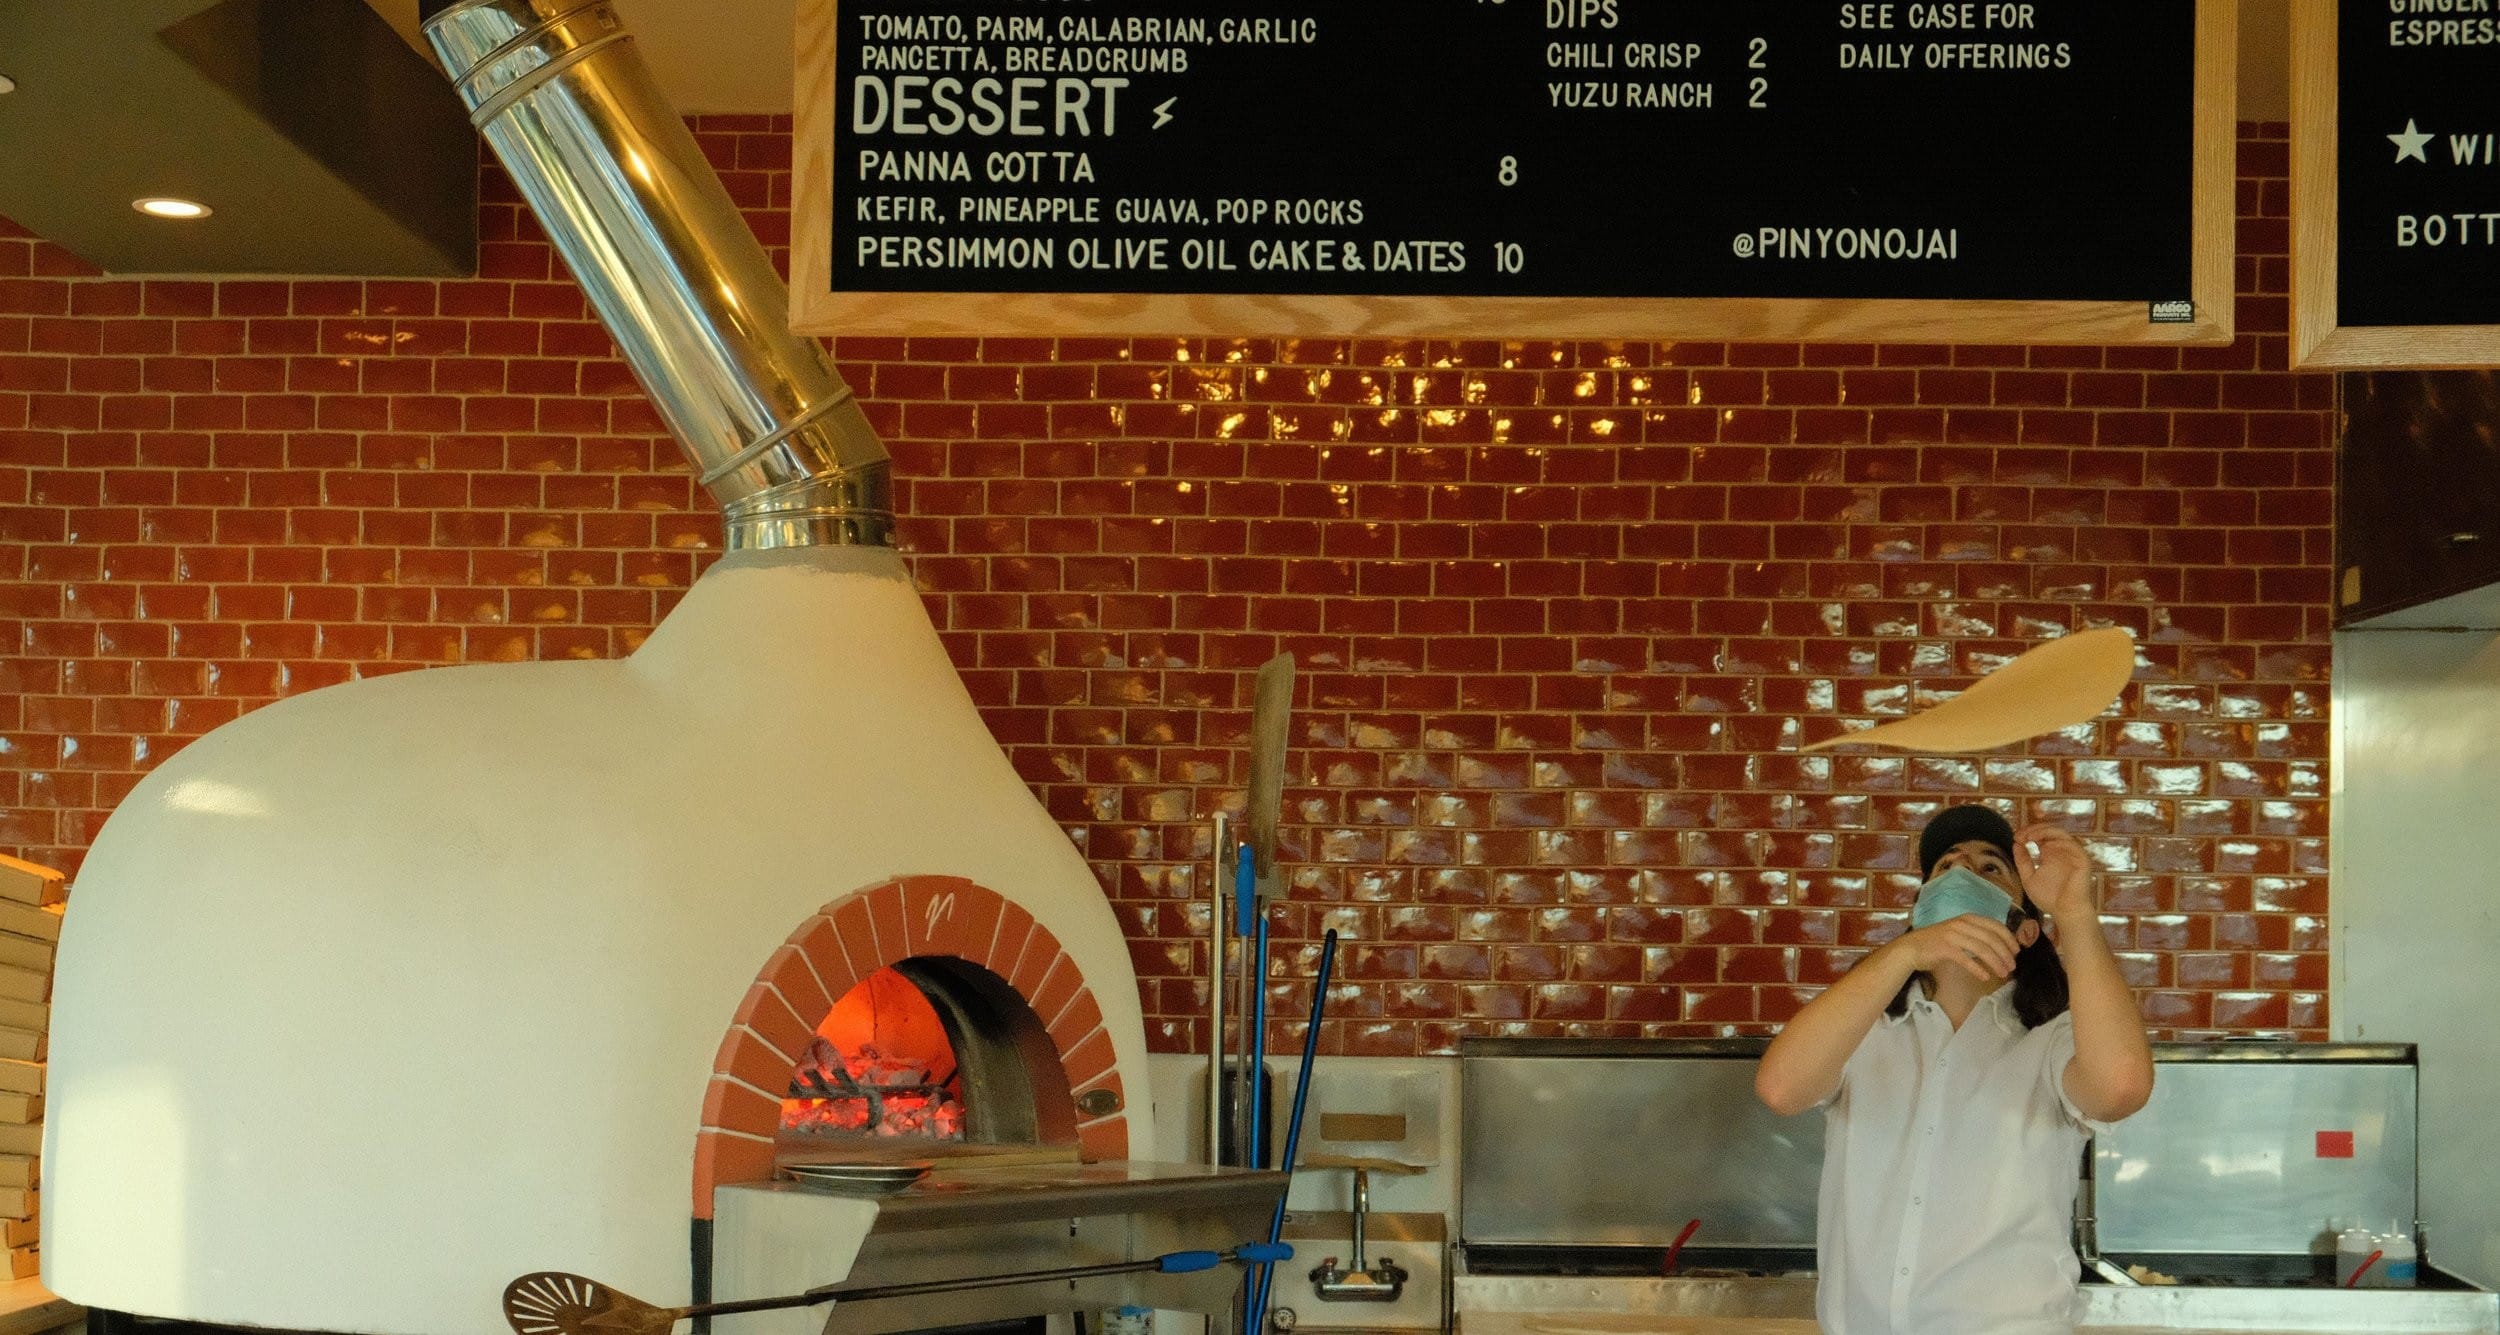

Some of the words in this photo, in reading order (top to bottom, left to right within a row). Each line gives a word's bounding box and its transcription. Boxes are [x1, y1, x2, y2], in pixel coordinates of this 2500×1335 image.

[1546, 0, 1619, 29] DIPS
[1839, 3, 1894, 29] SEE
[1908, 3, 1976, 29] CASE
[1985, 2, 2034, 29] FOR
[859, 15, 969, 44] TOMATO,
[976, 16, 1054, 45] PARM,
[1058, 16, 1214, 46] CALABRIAN,
[1219, 18, 1317, 44] GARLIC
[2389, 18, 2500, 47] ESPRES
[862, 45, 998, 74] PANCETTA,
[1005, 46, 1188, 73] BREADCRUMB
[1546, 42, 1614, 68] CHILI
[1624, 42, 1701, 69] CRISP
[1748, 37, 1768, 69] 2
[1840, 43, 1914, 69] DAILY
[1924, 42, 2071, 69] OFFERINGS
[853, 75, 1130, 137] DESSERT
[1548, 82, 1618, 108] YUZU
[1626, 82, 1713, 108] RANCH
[1748, 77, 1769, 108] 2
[2449, 133, 2500, 165] WI
[860, 150, 972, 182] PANNA
[986, 151, 1095, 183] COTTA
[1498, 155, 1518, 186] 8
[857, 195, 946, 225] KEFIR,
[959, 196, 1100, 223] PINEAPPLE
[1115, 198, 1210, 226] GUAVA,
[1216, 198, 1268, 225] POP
[1275, 198, 1364, 226] ROCKS
[1732, 227, 1957, 260] @PINYONOJAI
[2397, 213, 2500, 247] BOTT
[858, 236, 1054, 269] PERSIMMON
[1067, 237, 1169, 270] OLIVE
[1181, 238, 1237, 271] OIL
[1249, 239, 1336, 272] CAKE
[1342, 241, 1366, 272] &
[1373, 240, 1466, 273] DATES
[1494, 241, 1524, 274] 10
